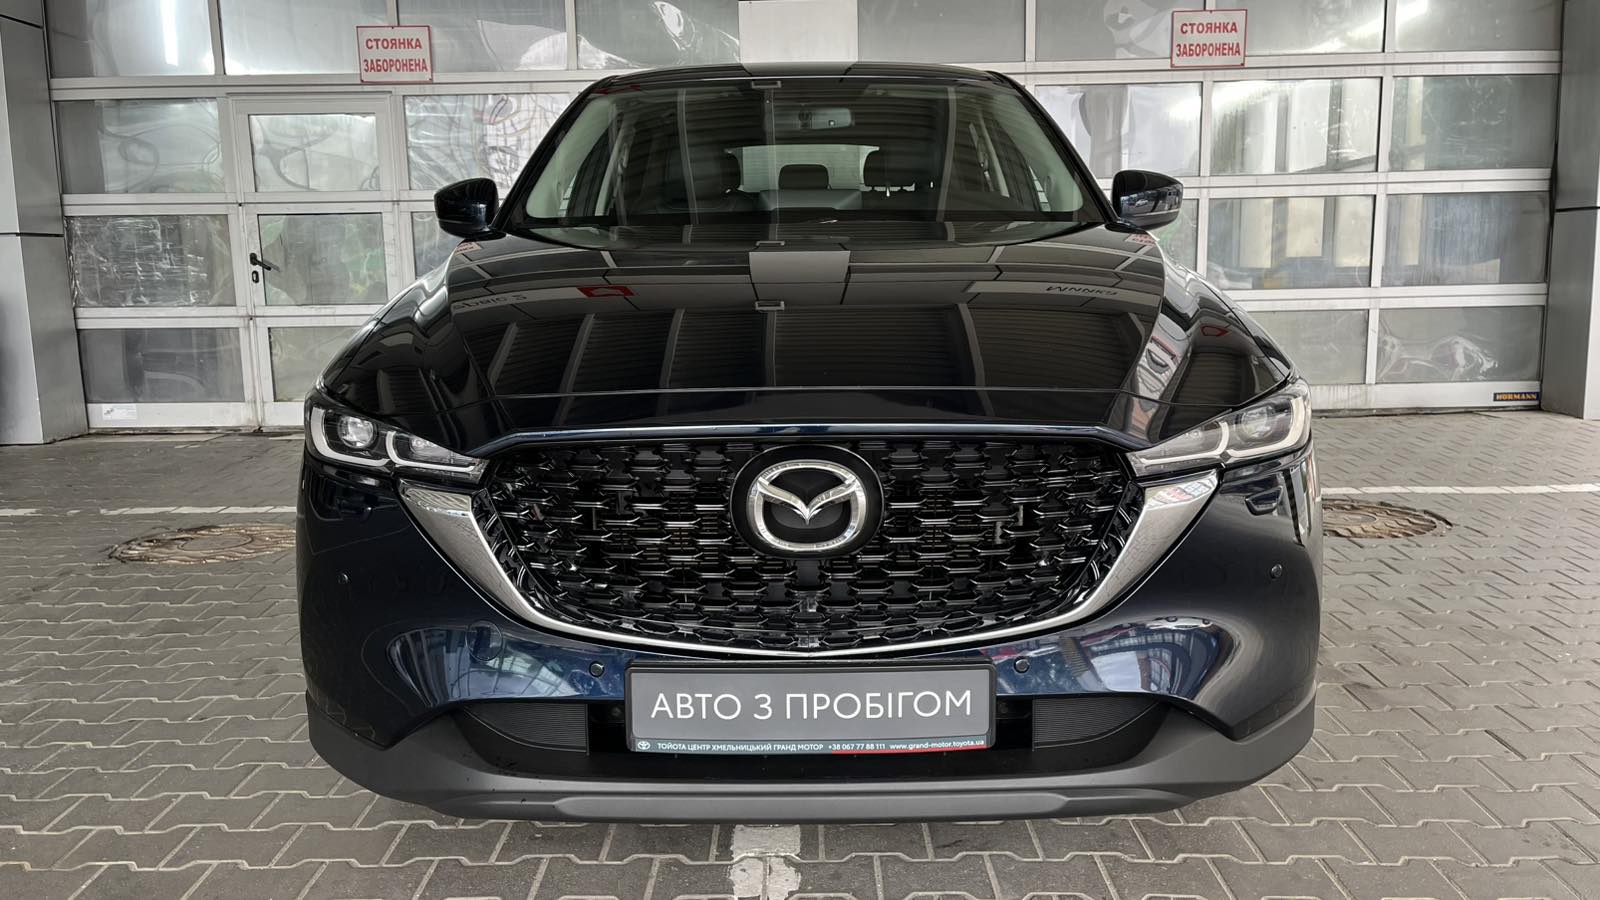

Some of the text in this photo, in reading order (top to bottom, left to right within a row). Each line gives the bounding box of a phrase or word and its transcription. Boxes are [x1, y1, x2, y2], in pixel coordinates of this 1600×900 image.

[1180, 22, 1238, 34] СТОЯНКА
[365, 38, 422, 50] СТОЯНКА
[1176, 43, 1241, 57] ЗАБОРОНЕНА
[363, 59, 428, 73] ЗАБОРОНЕНА
[651, 692, 742, 720] АВТО
[786, 690, 971, 720] ПРОБІГОМ
[657, 742, 687, 751] ТОЙОТА
[687, 743, 711, 752] ЦЕНТР
[711, 743, 772, 752] ХМЕЛЬНИЦЬКИЙ
[773, 743, 797, 752] ГРАНД
[797, 743, 824, 751] МОТОР
[828, 743, 841, 751] +38
[841, 743, 855, 751] 067
[855, 743, 865, 751] 77
[865, 743, 875, 751] 88
[889, 740, 985, 750] www.grand-motor.toyota.ua
